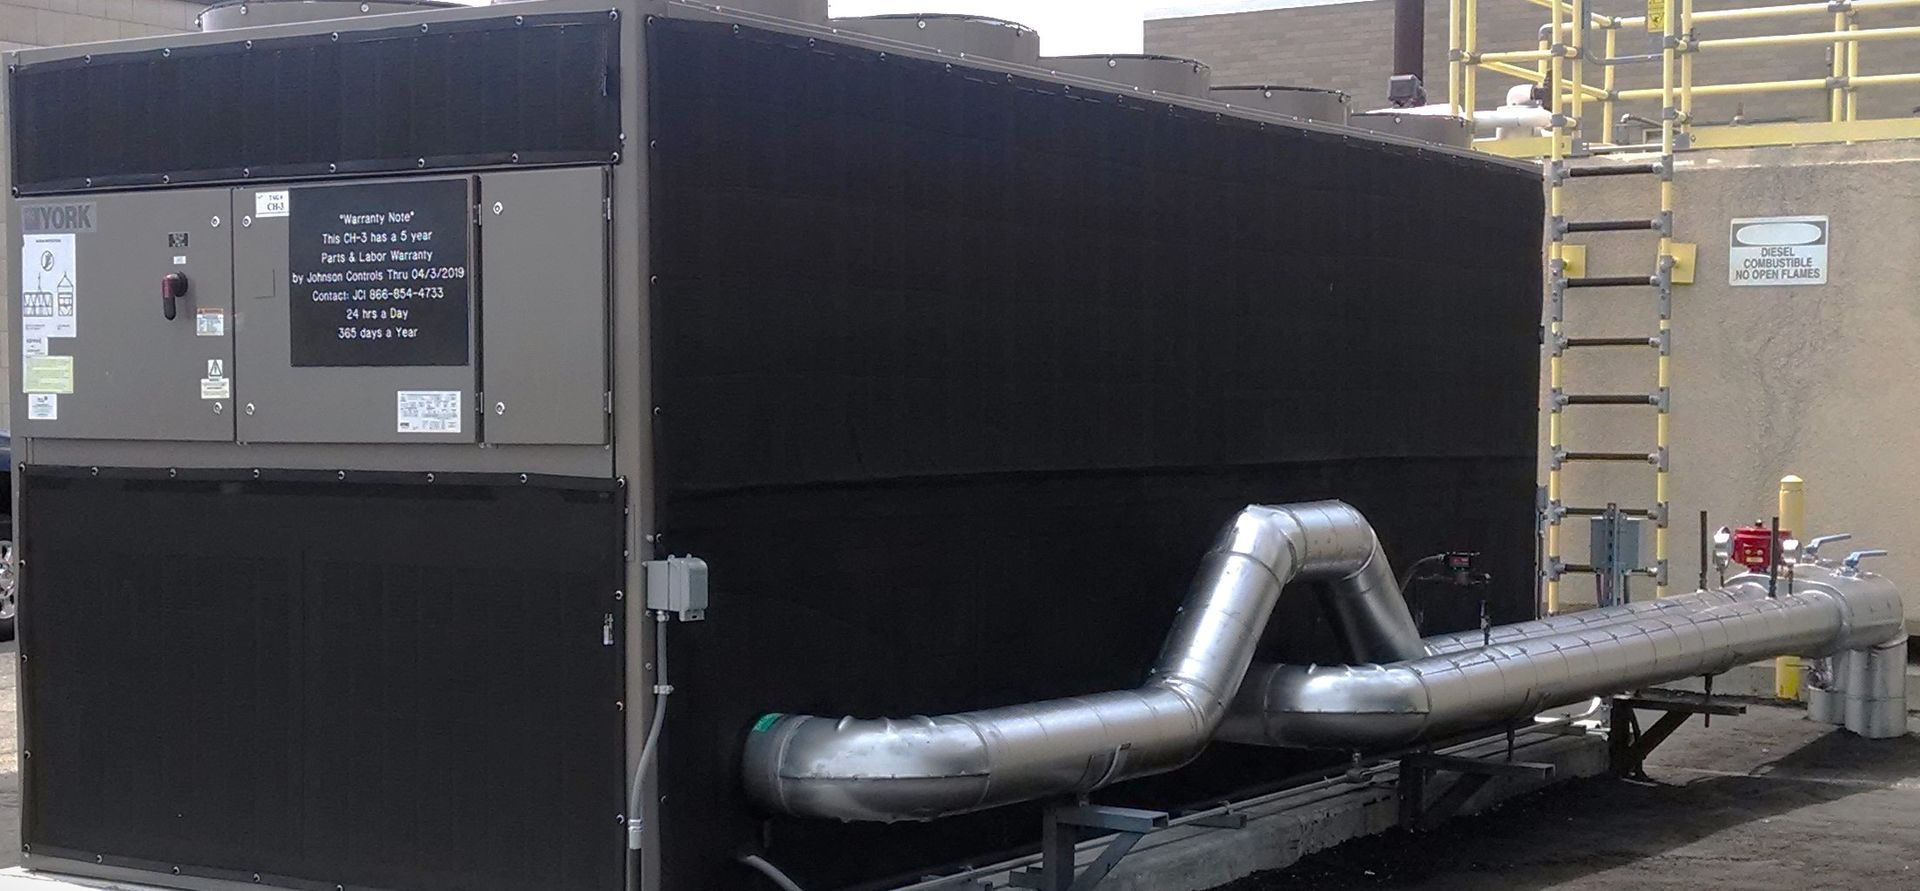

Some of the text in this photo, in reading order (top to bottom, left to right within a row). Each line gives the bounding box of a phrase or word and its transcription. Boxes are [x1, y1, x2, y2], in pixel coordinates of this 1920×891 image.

[267, 202, 284, 211] CH-3
[40, 205, 91, 229] YORK
[322, 230, 433, 245] This CH-3 has a 5 year
[321, 250, 433, 264] Parts & Labor Warranty
[1761, 247, 1795, 257] DIESEL
[1743, 257, 1813, 268] COMBUSTIBLE
[292, 267, 465, 285] by Johnson Controls Thru 04/3/2019
[1735, 268, 1820, 280] NO OPEN FLAMES
[312, 287, 444, 302] Contact: JCI 866-854-4733
[346, 307, 409, 320] 24 hrs a Day
[337, 327, 418, 340] 365 days a Year
